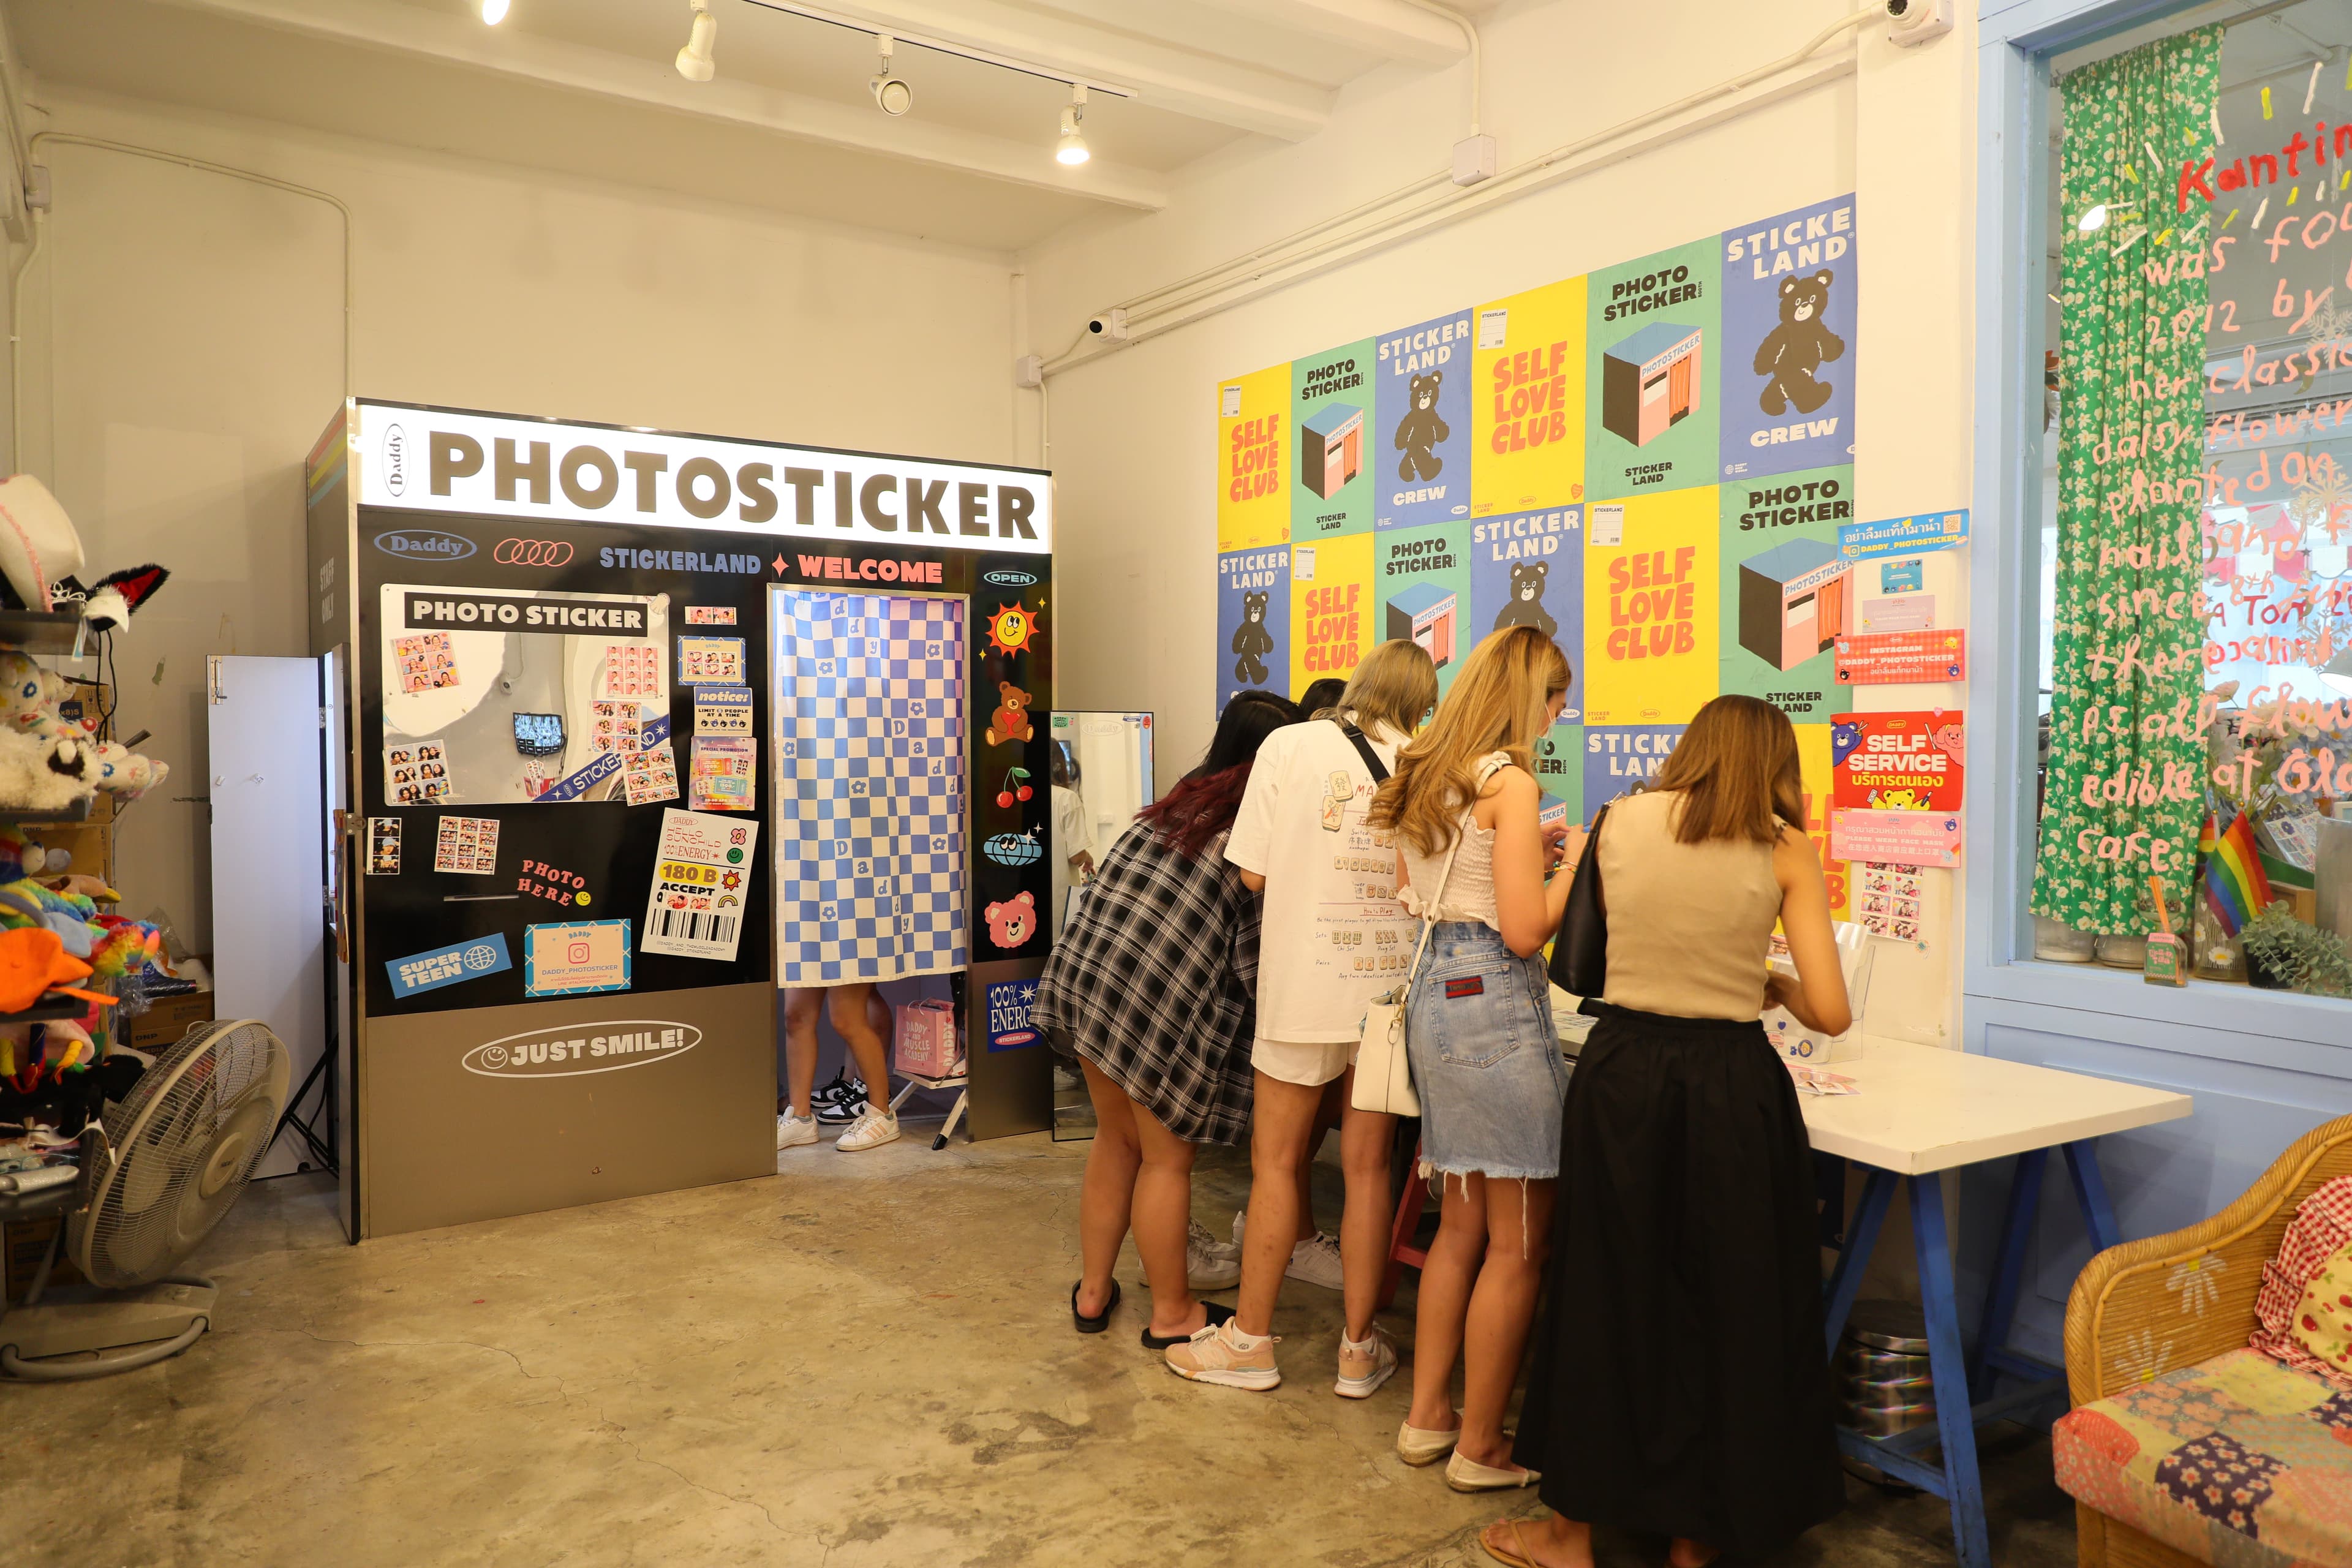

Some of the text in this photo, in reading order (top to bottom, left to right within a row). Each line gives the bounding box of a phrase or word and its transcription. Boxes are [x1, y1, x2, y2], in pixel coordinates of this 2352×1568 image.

[1728, 206, 1850, 262] STICKE
[1754, 235, 1847, 280] LAND
[2144, 236, 2236, 285] was
[1613, 265, 1689, 301] PHOTO
[1604, 283, 1697, 322] STICKER
[2146, 279, 2334, 345] 2012 by
[1379, 320, 1469, 361] STICKER
[1307, 359, 1355, 383] PHOTO
[1395, 345, 1451, 375] LAND
[1493, 341, 1567, 393] SELF
[1642, 335, 1700, 378] PHOTOSTICKER
[1302, 374, 1360, 401] STICKER
[1494, 375, 1566, 424] LOVE
[2130, 369, 2192, 401] her
[1231, 413, 1279, 453] SELF
[1326, 414, 1362, 446] PHOTOSTICKER
[1491, 411, 1566, 454] CLUB
[1750, 417, 1839, 447] CREW
[2092, 422, 2193, 466] daisy
[390, 435, 404, 486] Daddy
[1232, 440, 1279, 477] LOVE
[1625, 462, 1672, 477] STICKER
[429, 431, 1038, 539] PHOTOSTICKER
[1230, 469, 1279, 502] CLUB
[1632, 473, 1664, 486] LAND
[1393, 486, 1447, 505] CREW
[1749, 480, 1839, 509] PHOTO
[1316, 513, 1346, 524] STICKER
[1321, 521, 1341, 531] LAND
[1474, 510, 1580, 543] STICKER
[1740, 500, 1849, 531] STICKER
[391, 536, 463, 555] Daddy
[1392, 538, 1446, 558] PHOTO
[1492, 535, 1559, 562] LAND
[1861, 535, 1959, 552] DADDY_PHOTOSTICKER
[2099, 521, 2193, 570] nail
[320, 557, 334, 592] STAFF
[600, 547, 761, 574] STICKERLAND
[797, 554, 942, 583] WELCOME
[1220, 552, 1288, 574] STICKER
[1386, 554, 1452, 576] STICKER
[1609, 546, 1695, 594] SELF
[991, 573, 1030, 583] OPEN
[1232, 571, 1275, 589] LAND
[322, 592, 333, 625] ONLY
[1305, 584, 1360, 619] SELF
[1414, 598, 1455, 627] PHOTOSTICKER
[1610, 582, 1694, 627] LOVE
[2099, 570, 2275, 628] since 8th
[413, 600, 642, 628] PHOTO STICKER
[1306, 612, 1359, 645] LOVE
[1607, 622, 1695, 661] CLUB
[1304, 643, 1359, 672] CLUB
[1838, 655, 1954, 666] @DADDY_PHOTOSTICKER
[2086, 634, 2222, 687] there
[698, 691, 748, 702] notice!
[1766, 692, 1822, 702] STICKER
[2144, 694, 2220, 744] all
[1588, 734, 1679, 754] STICK
[1867, 735, 1926, 752] SELF
[1848, 754, 1947, 772] SERVICE
[1852, 772, 1943, 786] บริการตนเอง
[2082, 750, 2263, 808] edible at
[666, 834, 721, 848] SUNCHILD
[667, 827, 703, 837] HELLO
[678, 846, 711, 860] ENERGY
[522, 860, 585, 889] PHOTO
[663, 864, 717, 883] 180 B
[517, 878, 573, 907] HERE
[660, 883, 715, 895] ACCEPT
[1379, 907, 1393, 916] Play
[398, 952, 462, 977] SUPER
[402, 963, 463, 988] TEEN
[542, 965, 617, 975] DADDY_PHOTOSTICKER
[990, 985, 1017, 1008] 100%
[907, 1022, 927, 1035] DADDY
[991, 1005, 1034, 1033] ENERG
[511, 1028, 684, 1066] JUST SMILE!
[903, 1038, 930, 1050] MUSCLE
[943, 1022, 954, 1066] DADDY
[999, 1034, 1031, 1043] STICKERLAND
[905, 1049, 928, 1061] ACADEMY
